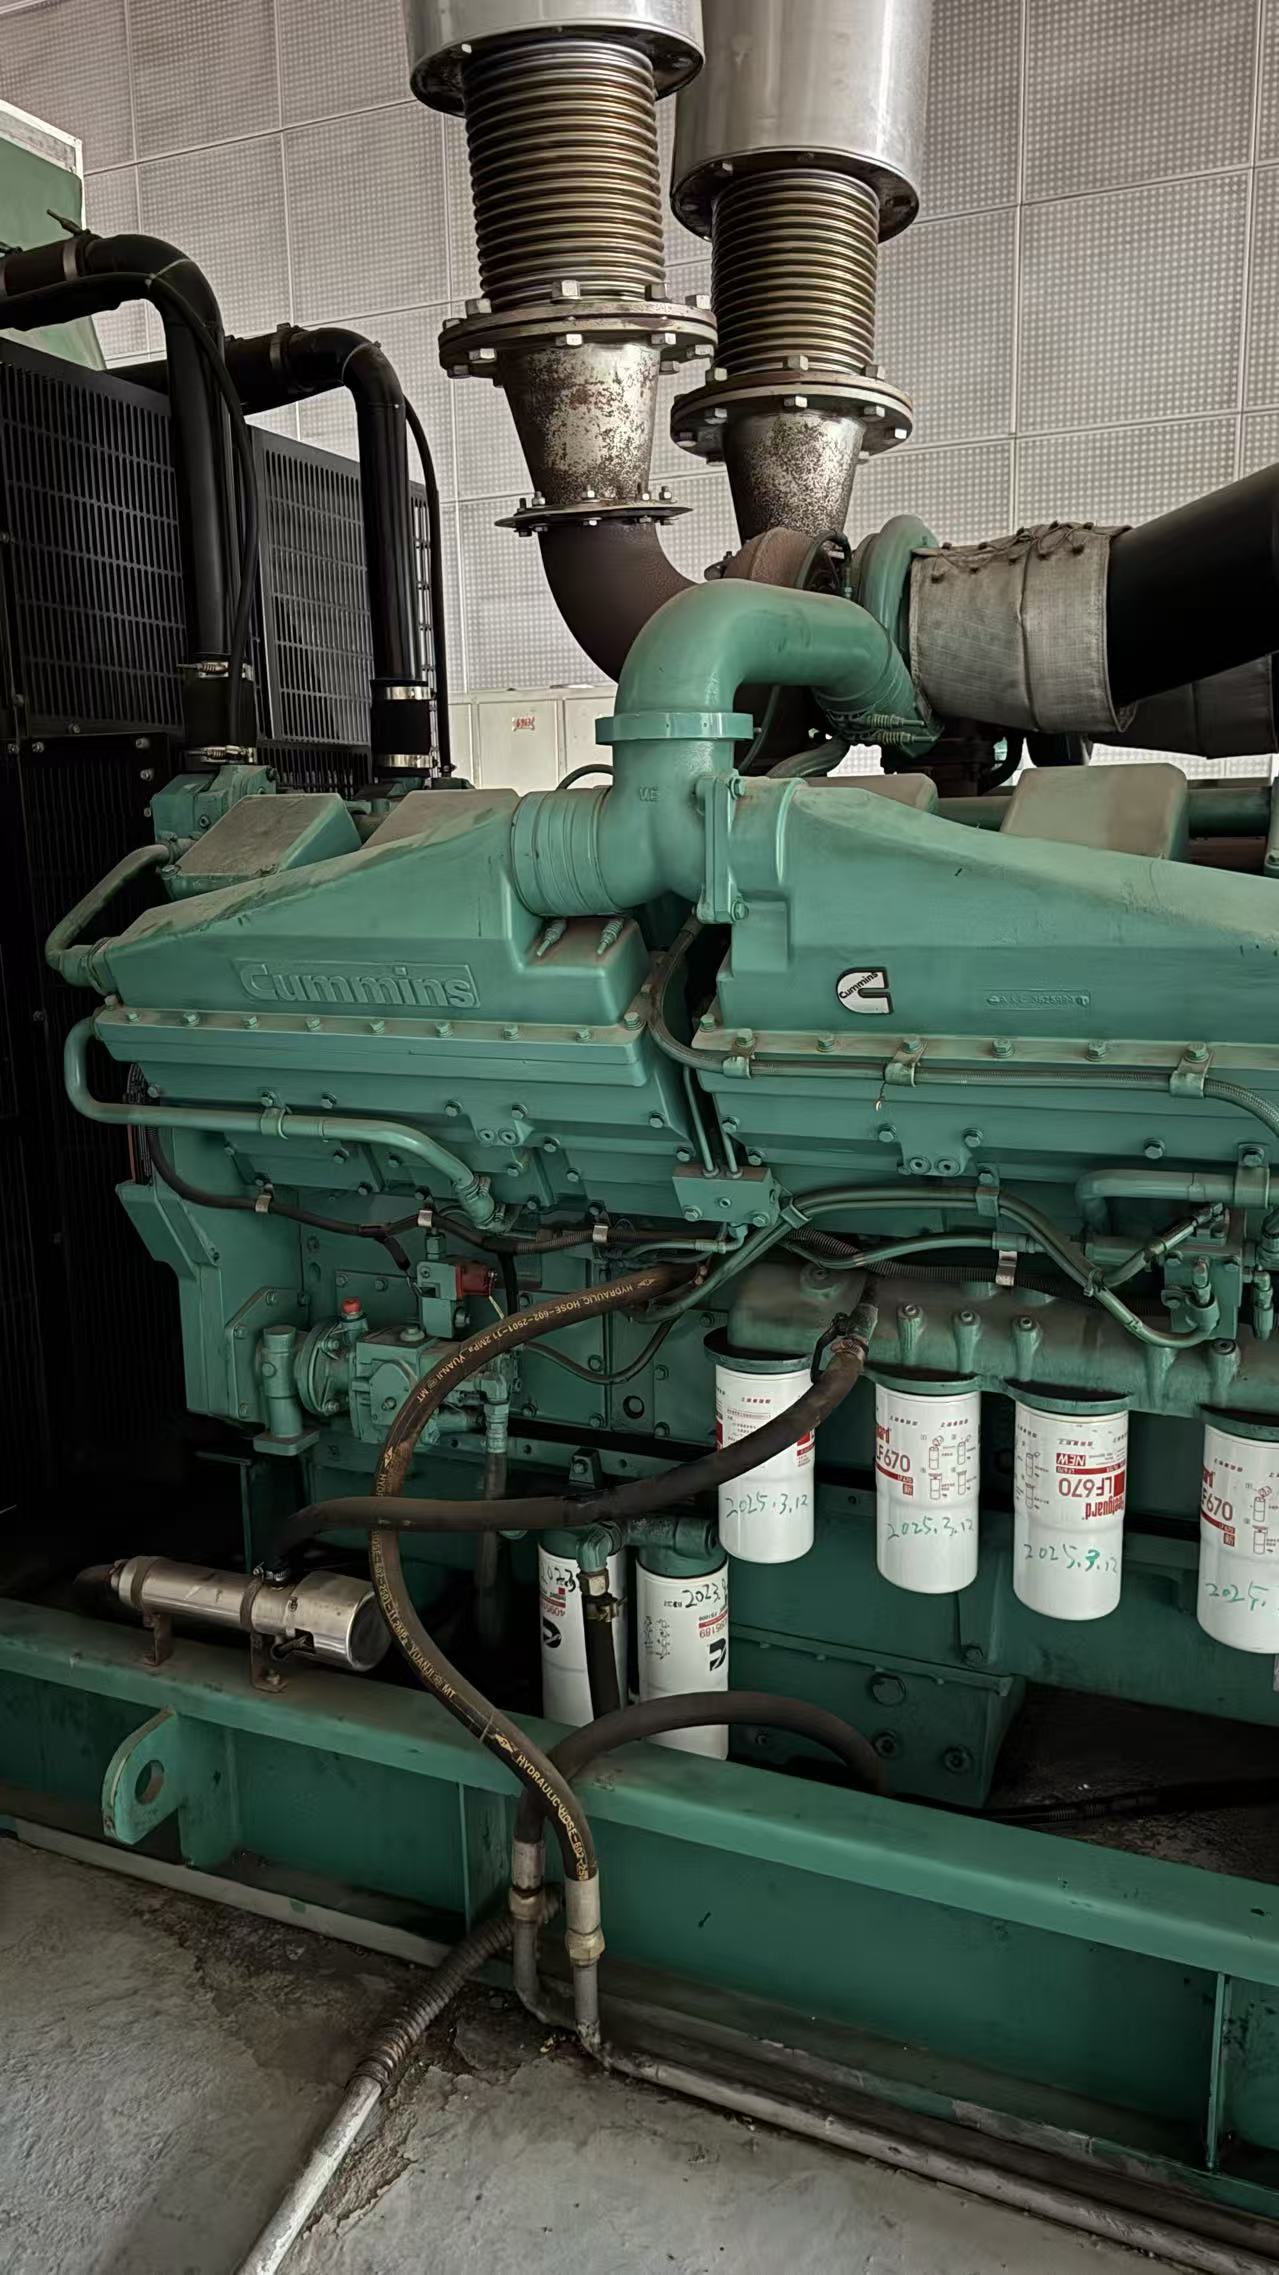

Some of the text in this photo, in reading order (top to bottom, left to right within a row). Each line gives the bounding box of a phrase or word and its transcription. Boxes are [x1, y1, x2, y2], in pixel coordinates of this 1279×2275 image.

[240, 963, 477, 1008] Cummins
[839, 972, 879, 999] Cummins
[585, 1283, 634, 1305] HYDRAULIC
[435, 1353, 467, 1380] YUANJI
[415, 1388, 431, 1403] MT
[1057, 1453, 1086, 1467] NEW
[1058, 1476, 1112, 1498] LF670
[725, 1491, 808, 1519] 2025.3.12
[887, 1515, 975, 1541] 2025.3.12
[516, 1754, 561, 1808] HYDRAULIC
